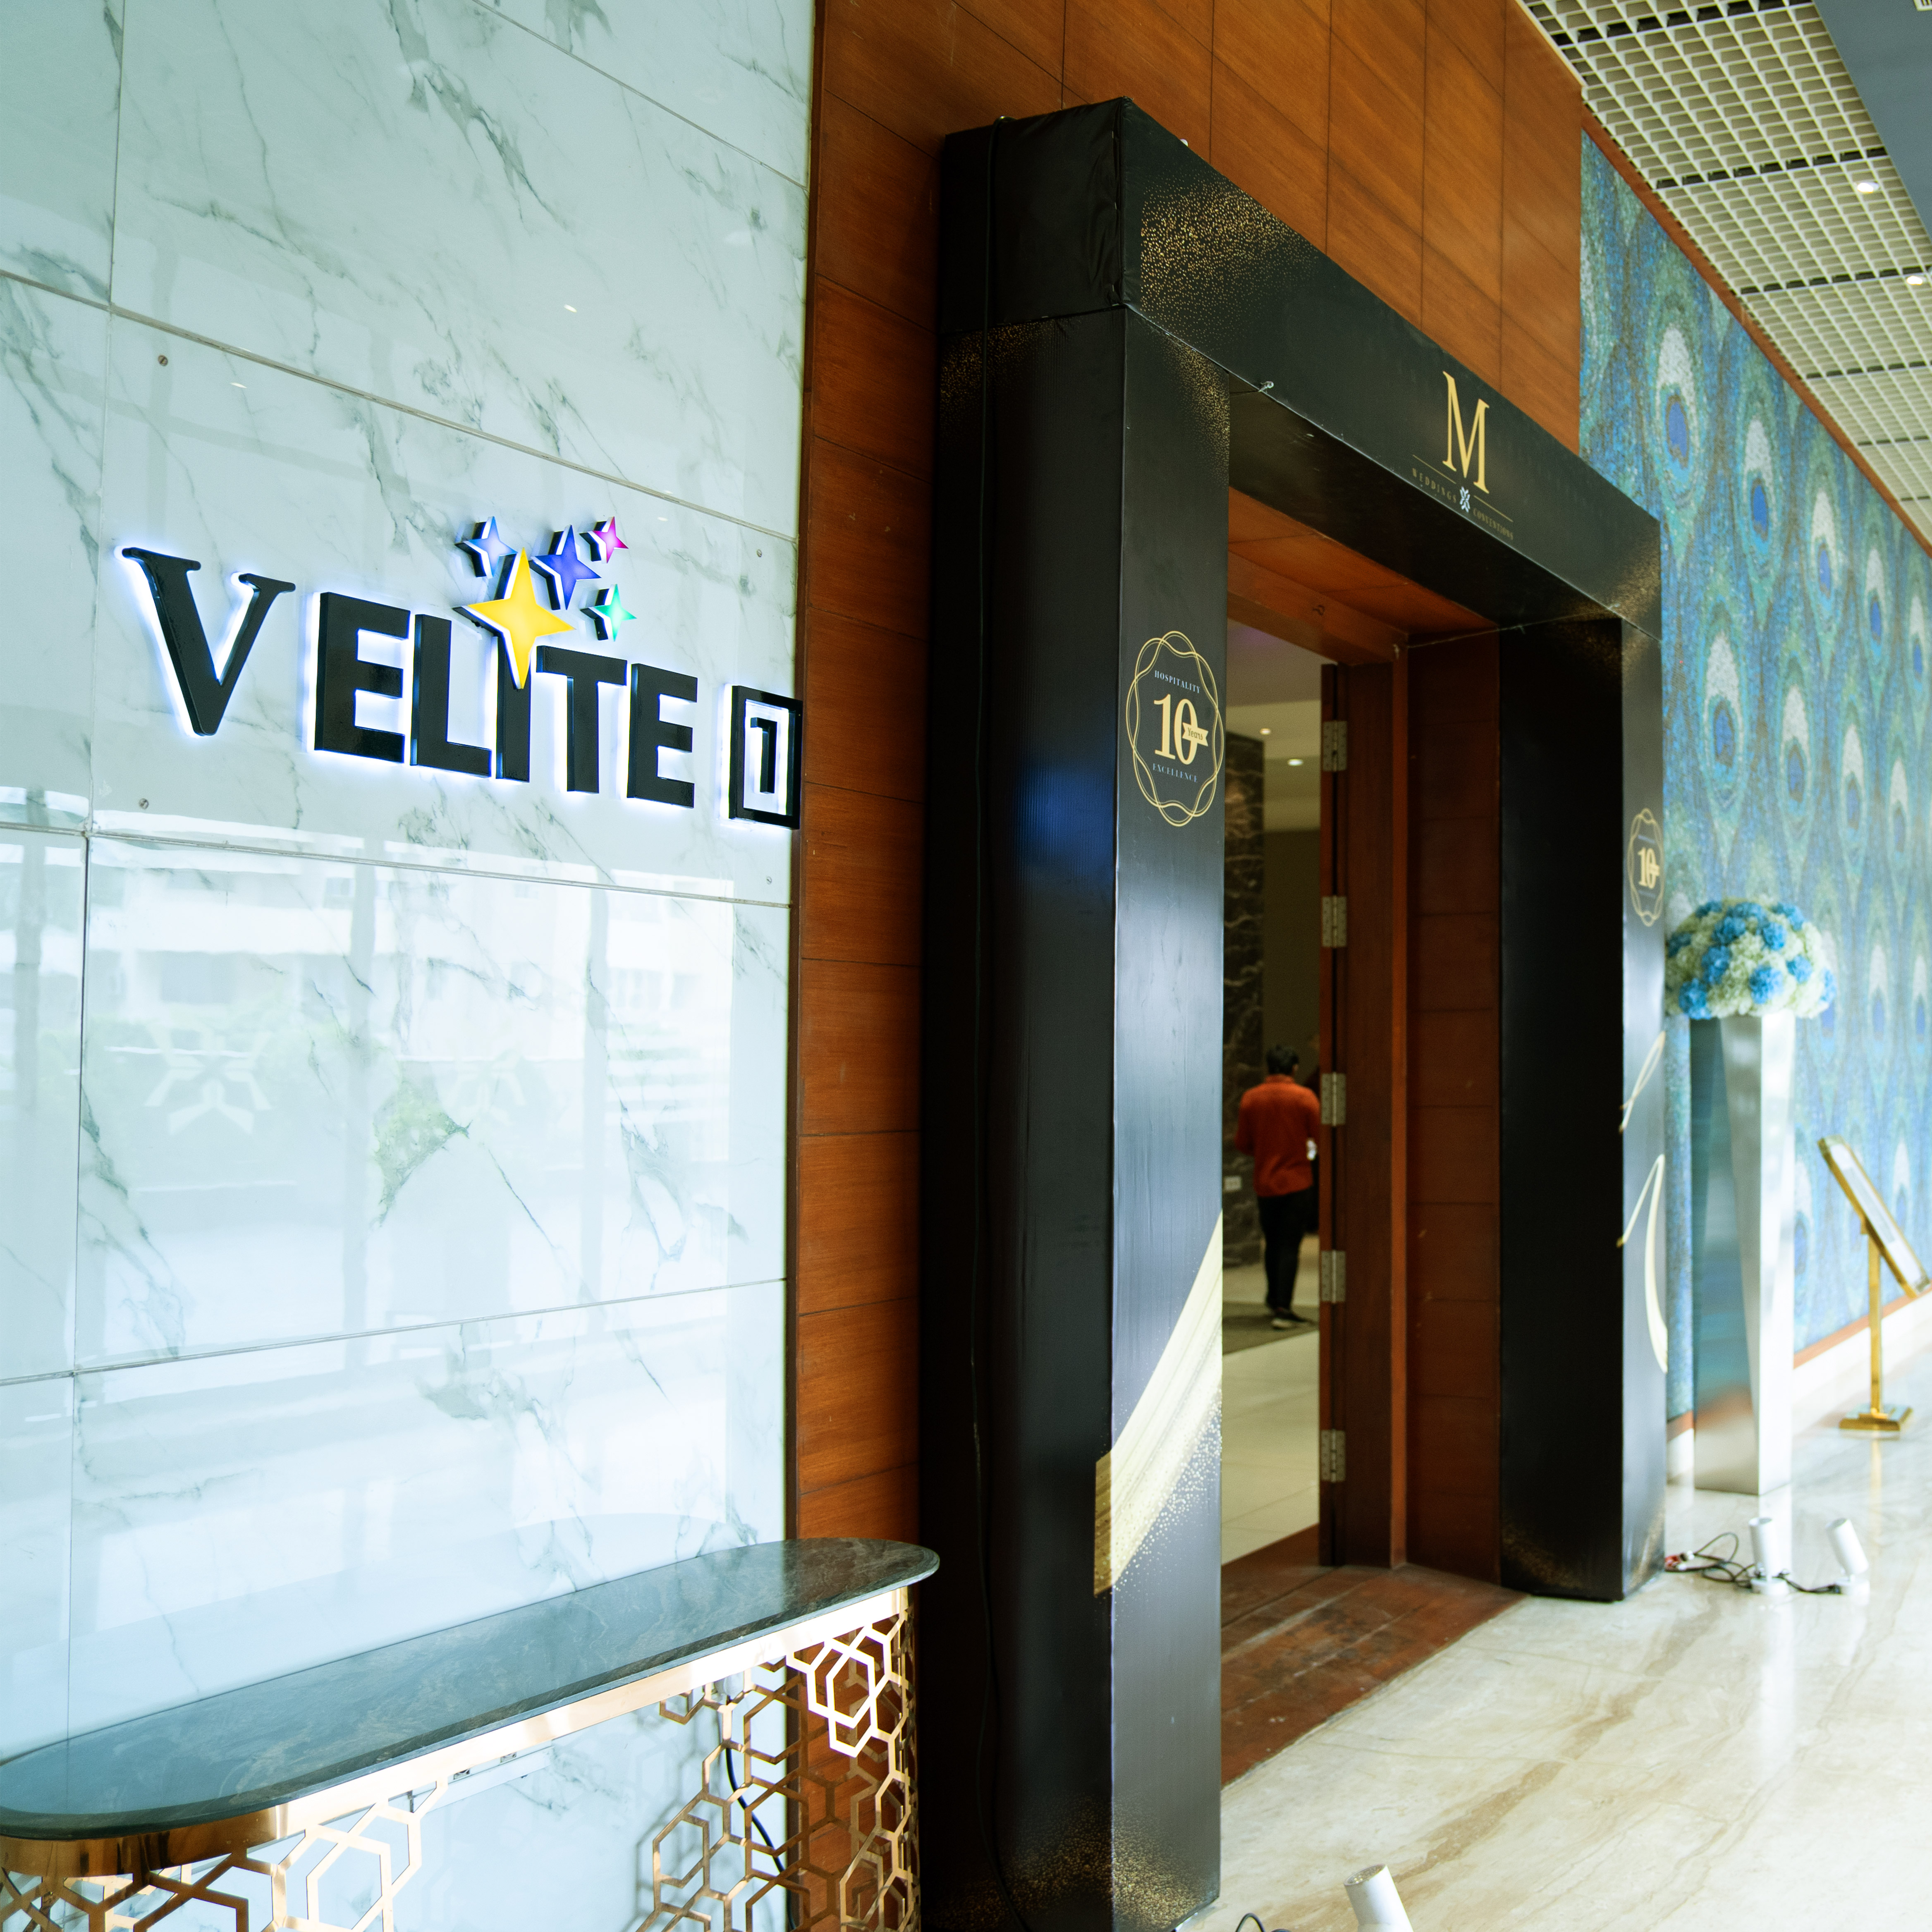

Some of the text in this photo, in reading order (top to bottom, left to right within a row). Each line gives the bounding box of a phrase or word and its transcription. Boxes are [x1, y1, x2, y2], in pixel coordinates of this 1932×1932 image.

[1442, 371, 1490, 494] M
[1155, 670, 1200, 693] HOSPITALITY
[1154, 694, 1198, 765] 10
[1188, 727, 1203, 740] Years
[1153, 763, 1198, 783] EXCELLENCE
